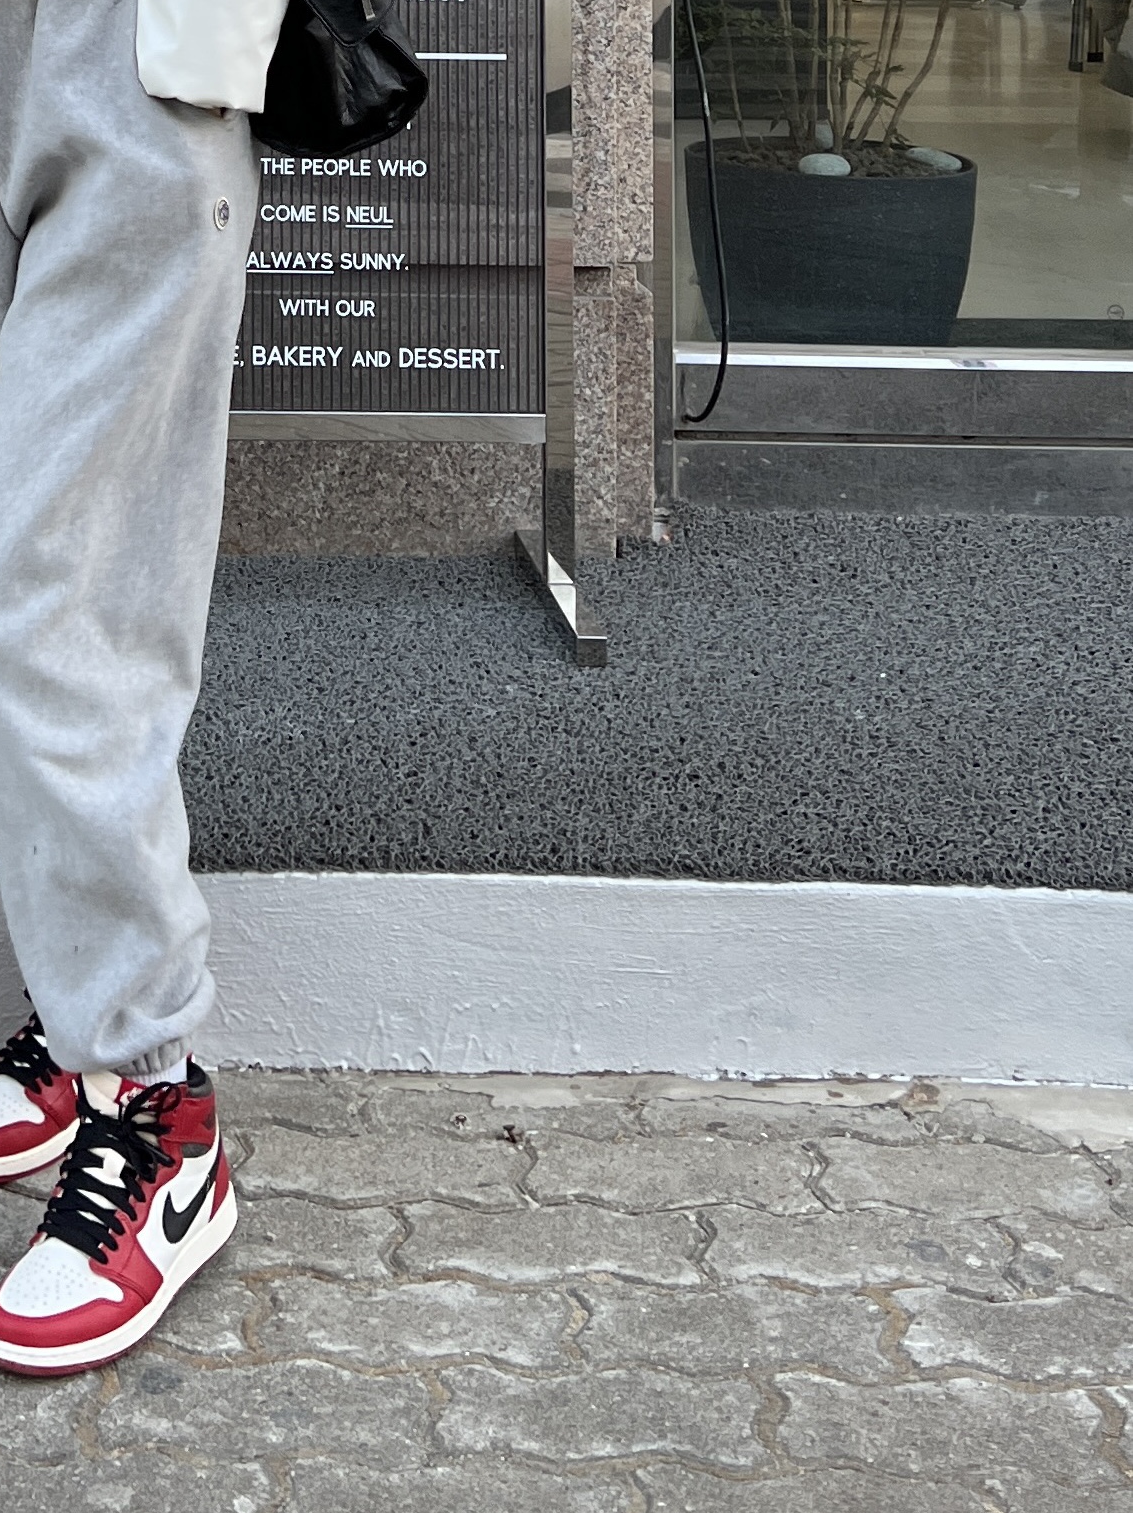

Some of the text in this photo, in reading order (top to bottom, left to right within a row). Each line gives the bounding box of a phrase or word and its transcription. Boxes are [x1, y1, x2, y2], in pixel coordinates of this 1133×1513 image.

[261, 157, 427, 177] THE PEOPLE WHO
[260, 204, 394, 223] COME IS NEUL
[246, 251, 409, 270] ALWAYS SUNNY.
[279, 298, 375, 317] WITH OUR
[252, 345, 343, 367] BAKERY
[352, 350, 391, 368] AND
[399, 347, 505, 370] DESSERT.
